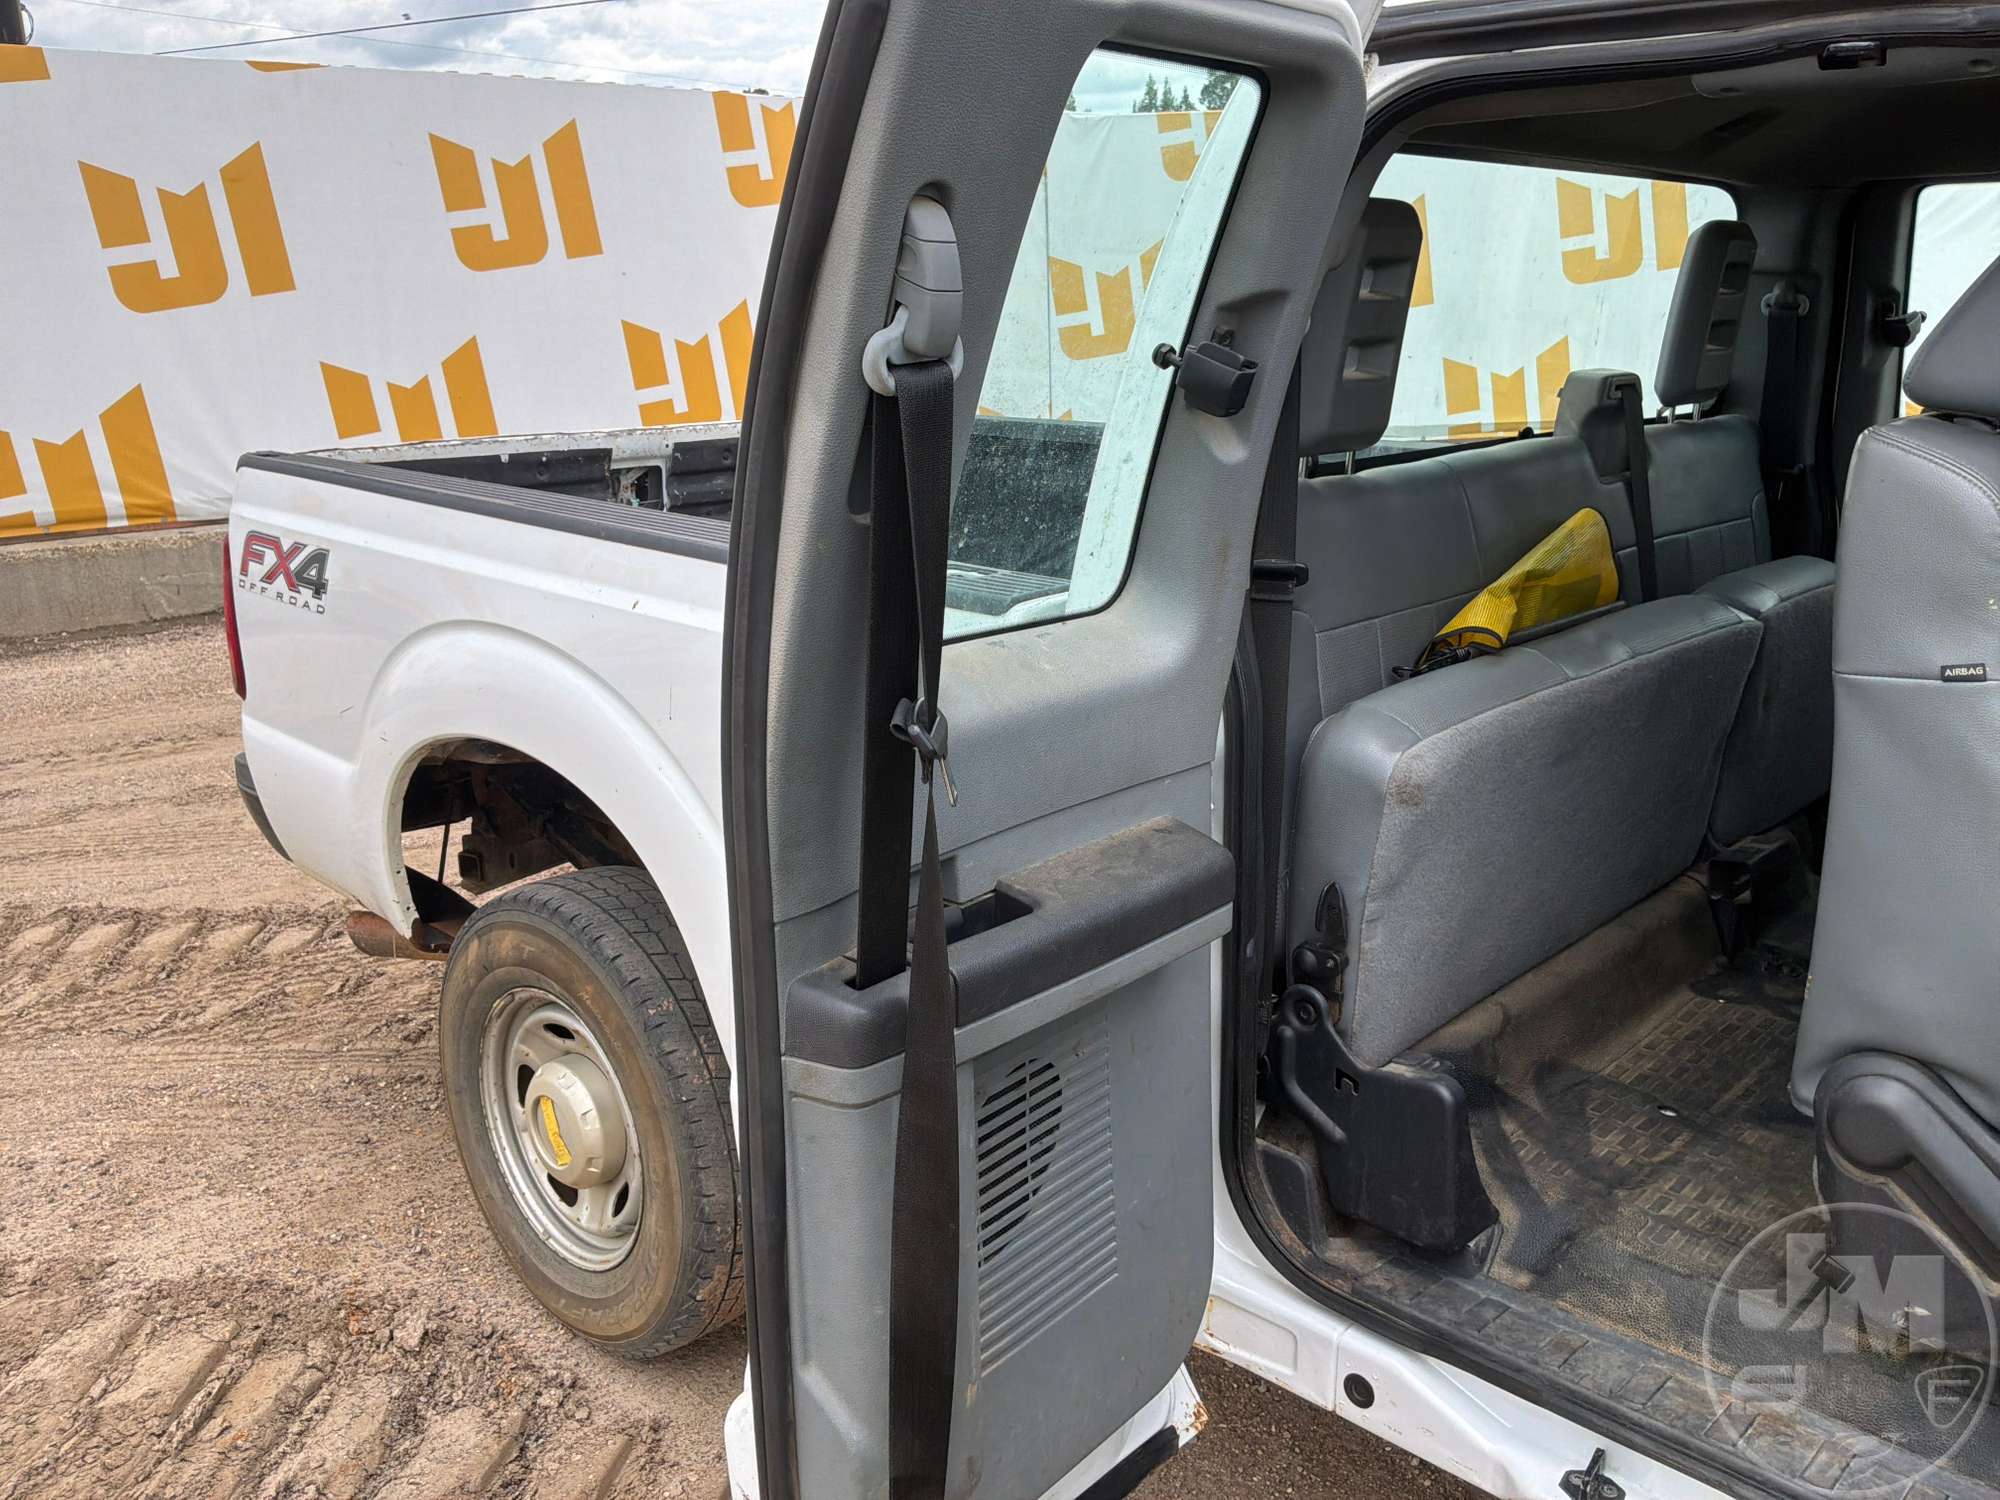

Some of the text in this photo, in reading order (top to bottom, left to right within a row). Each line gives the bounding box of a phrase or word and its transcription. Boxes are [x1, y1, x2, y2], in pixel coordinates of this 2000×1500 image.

[241, 531, 330, 600] FX4
[239, 580, 325, 614] OFF ROAD
[1944, 667, 1983, 676] AIRBAG
